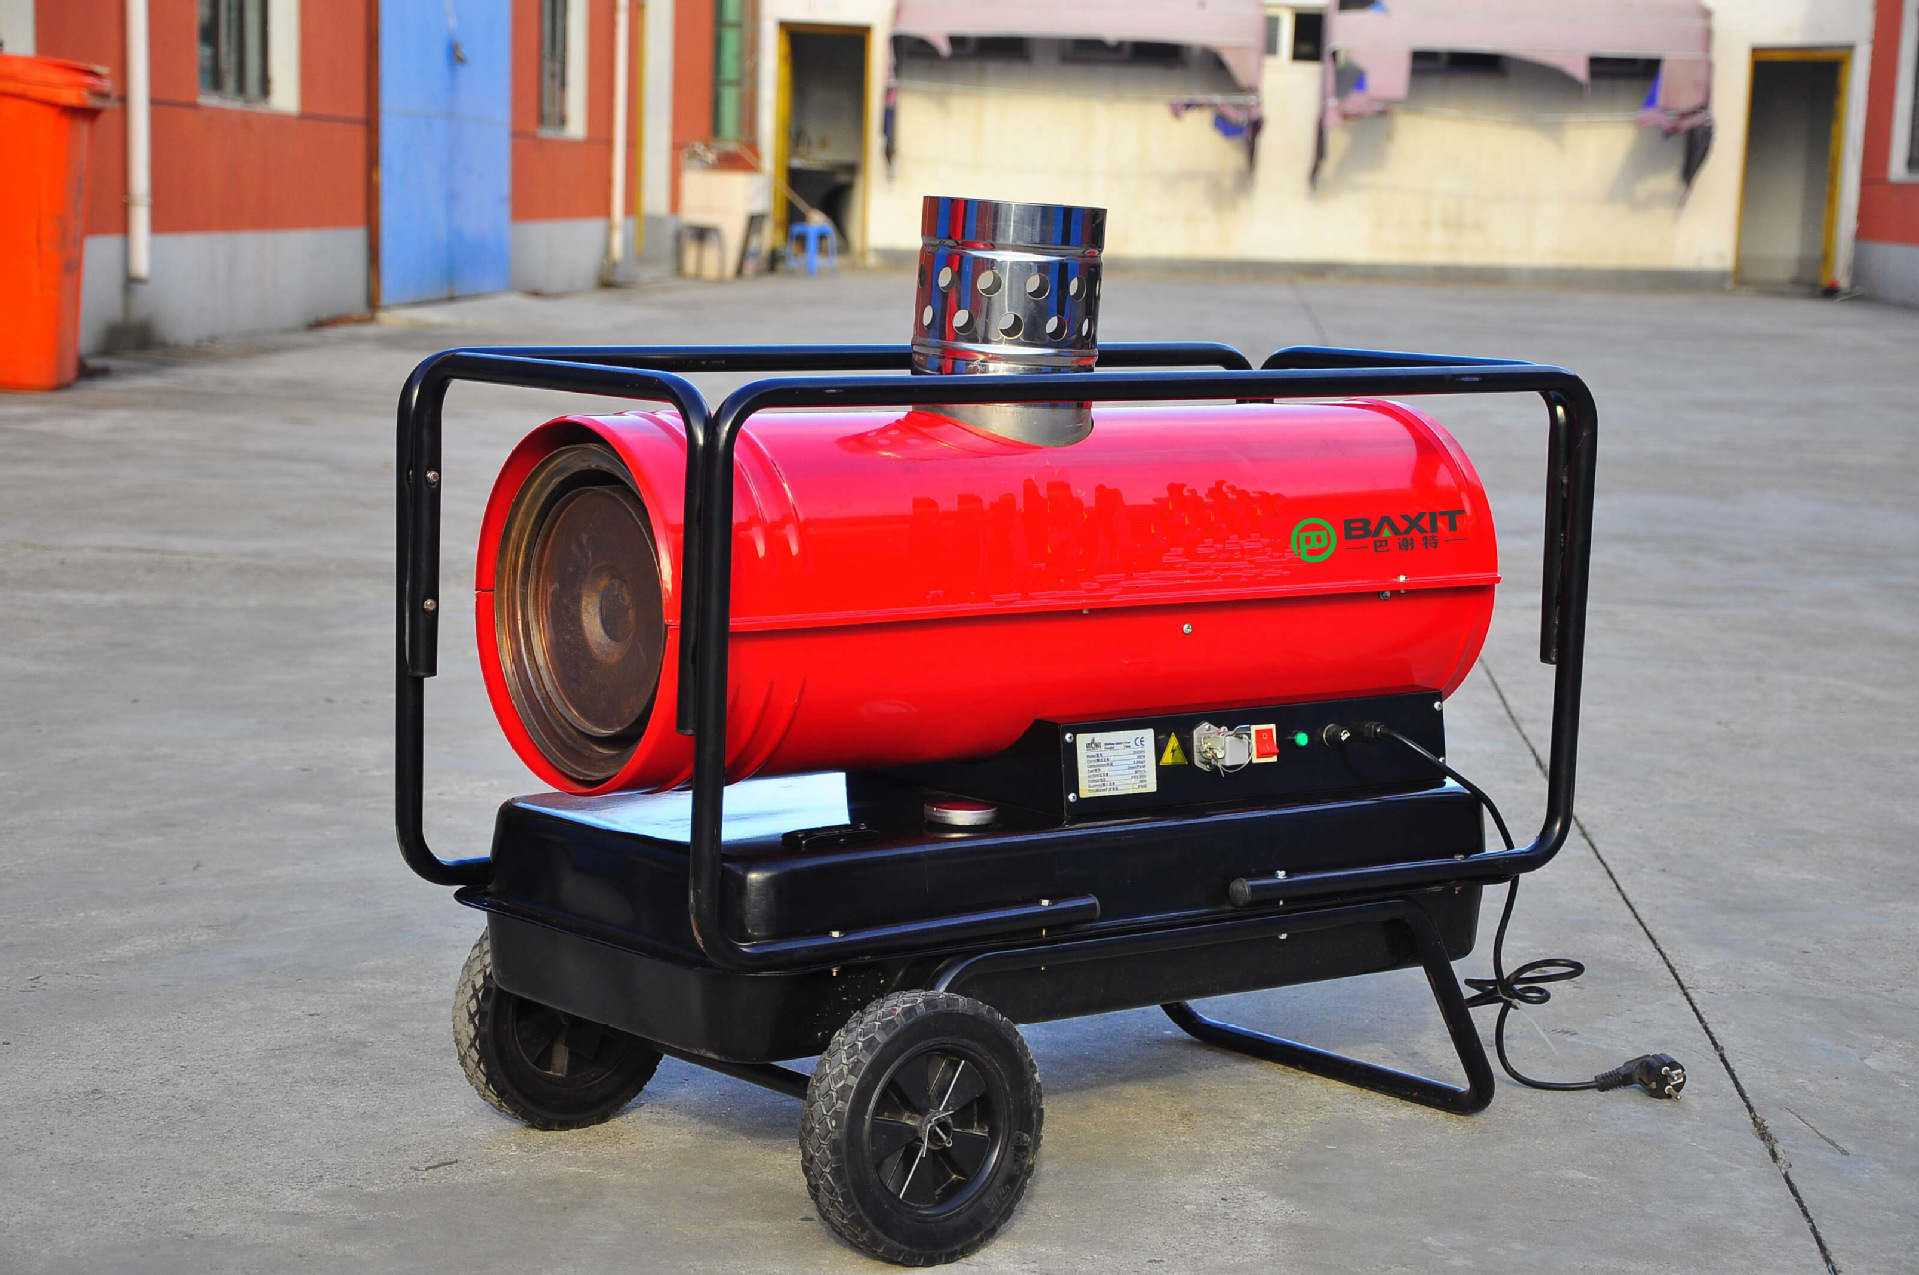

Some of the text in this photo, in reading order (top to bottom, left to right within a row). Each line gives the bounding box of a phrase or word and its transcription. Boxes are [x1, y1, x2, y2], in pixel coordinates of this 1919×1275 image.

[1343, 510, 1466, 540] BAXIT
[1373, 535, 1439, 553] 巴谢特
